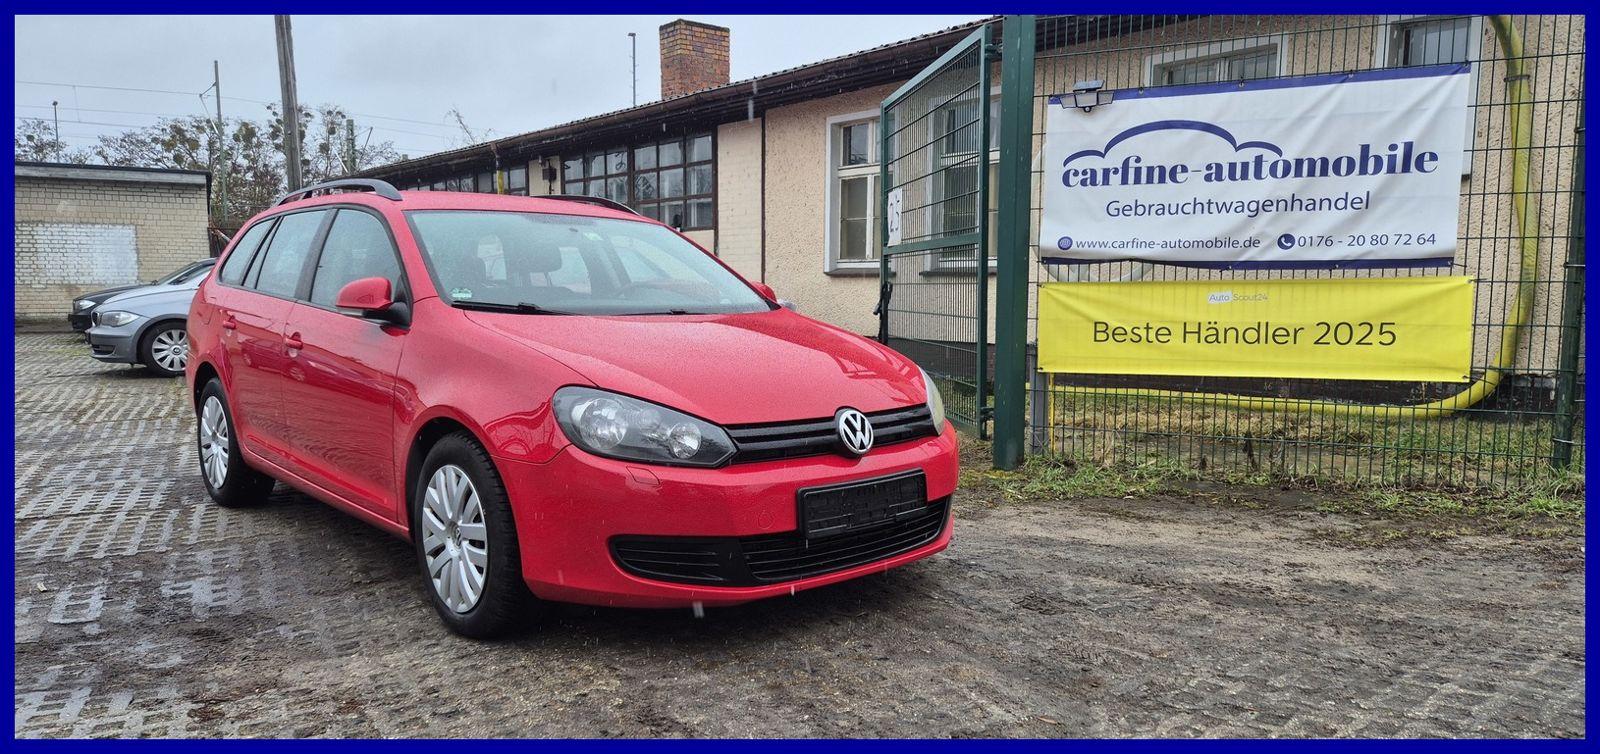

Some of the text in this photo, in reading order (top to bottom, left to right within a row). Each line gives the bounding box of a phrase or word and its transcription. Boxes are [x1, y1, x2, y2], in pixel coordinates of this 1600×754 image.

[1061, 141, 1440, 188] carfine-automobile
[1105, 191, 1371, 218] Gebrauchtwagenhandel
[1075, 236, 1261, 250] www.carfine-automobile.de
[1297, 235, 1334, 248] 0176
[1347, 234, 1367, 247] 20
[1370, 234, 1389, 247] 80
[1393, 233, 1412, 246] 72
[1416, 233, 1437, 245] 64
[1093, 320, 1398, 346] Beste Händler 2025
